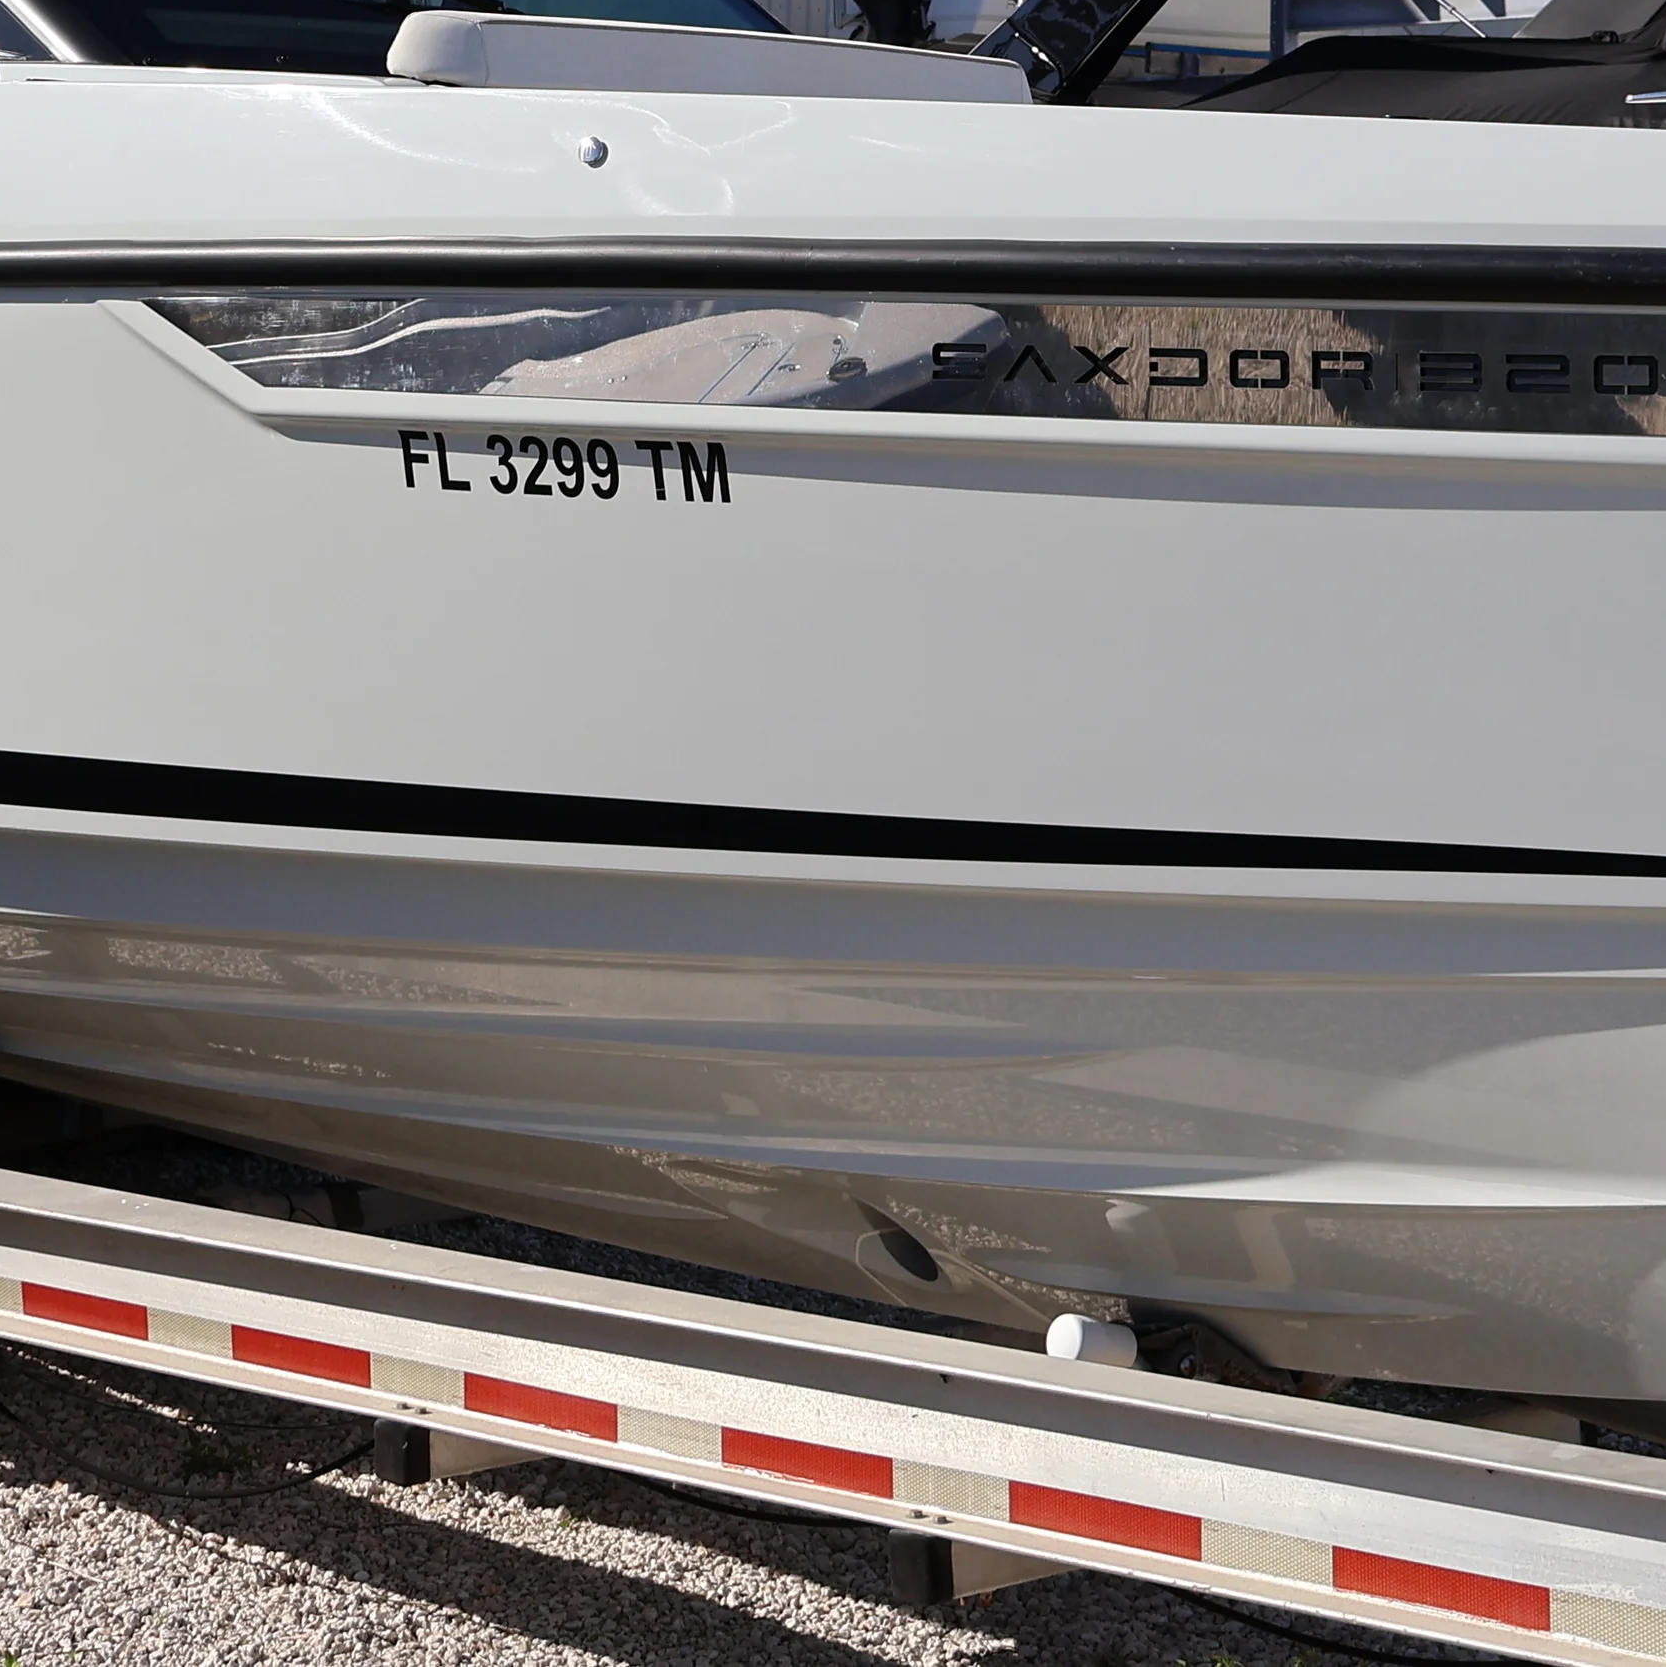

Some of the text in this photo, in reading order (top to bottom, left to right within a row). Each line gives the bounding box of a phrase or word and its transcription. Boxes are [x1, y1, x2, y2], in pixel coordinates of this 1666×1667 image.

[932, 342, 1659, 395] SAXDOR 320
[397, 429, 731, 503] FL 3299 TM
